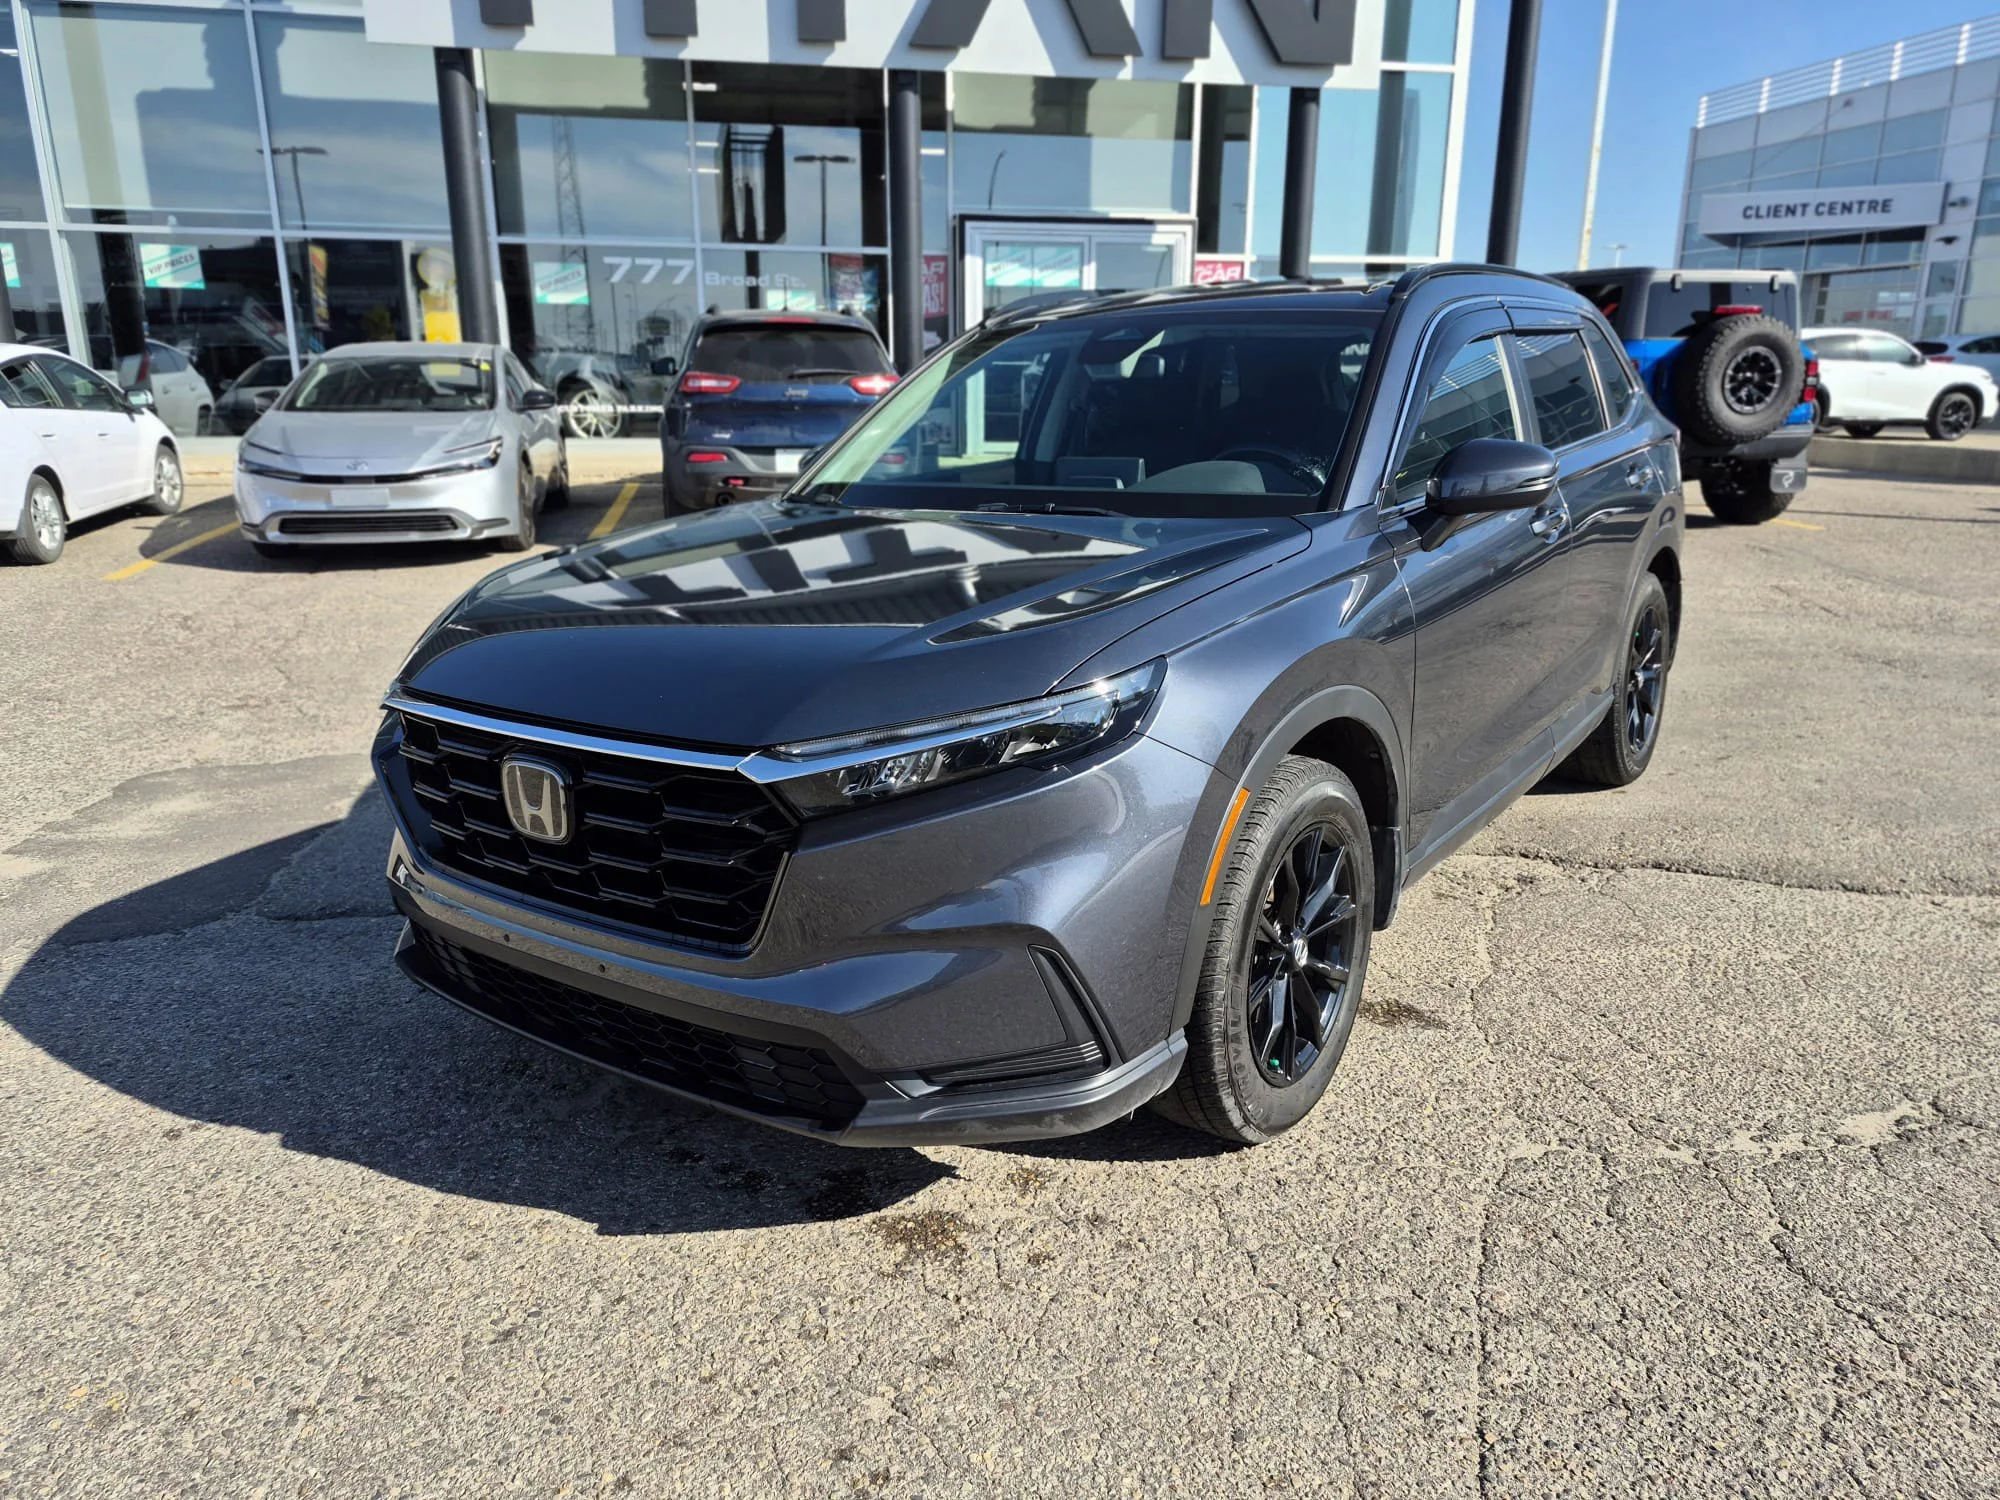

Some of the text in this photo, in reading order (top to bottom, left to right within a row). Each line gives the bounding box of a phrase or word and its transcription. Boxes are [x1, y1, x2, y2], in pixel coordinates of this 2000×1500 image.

[1742, 198, 1893, 219] CLIENT CENTRE
[603, 256, 695, 284] 777
[704, 272, 770, 287] Broad
